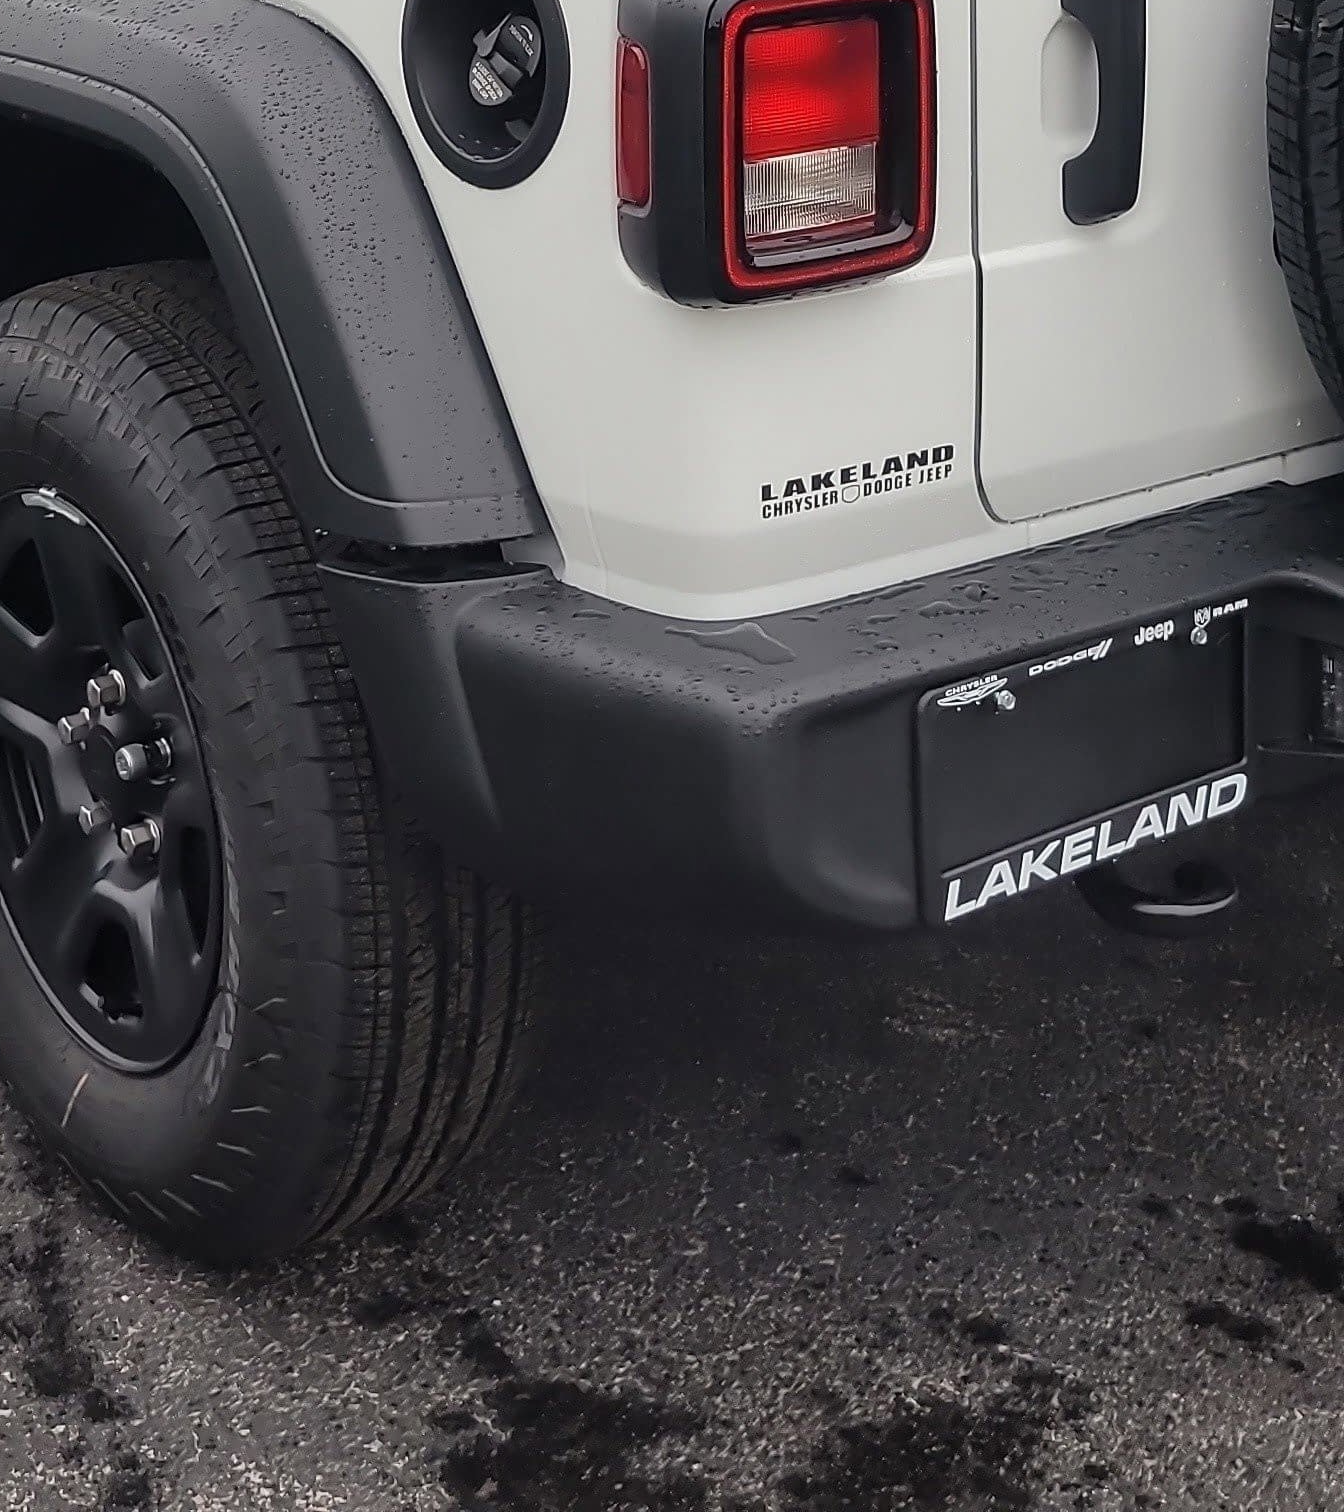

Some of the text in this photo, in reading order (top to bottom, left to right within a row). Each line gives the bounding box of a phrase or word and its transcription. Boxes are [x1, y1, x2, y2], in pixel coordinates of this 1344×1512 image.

[760, 444, 954, 502] LAKELAND
[761, 464, 953, 519] CHRYSLER DODGE JEEP
[945, 598, 1248, 697] CHRYSLER DODGE Jeep RAM
[944, 773, 1248, 921] LAKELAND
